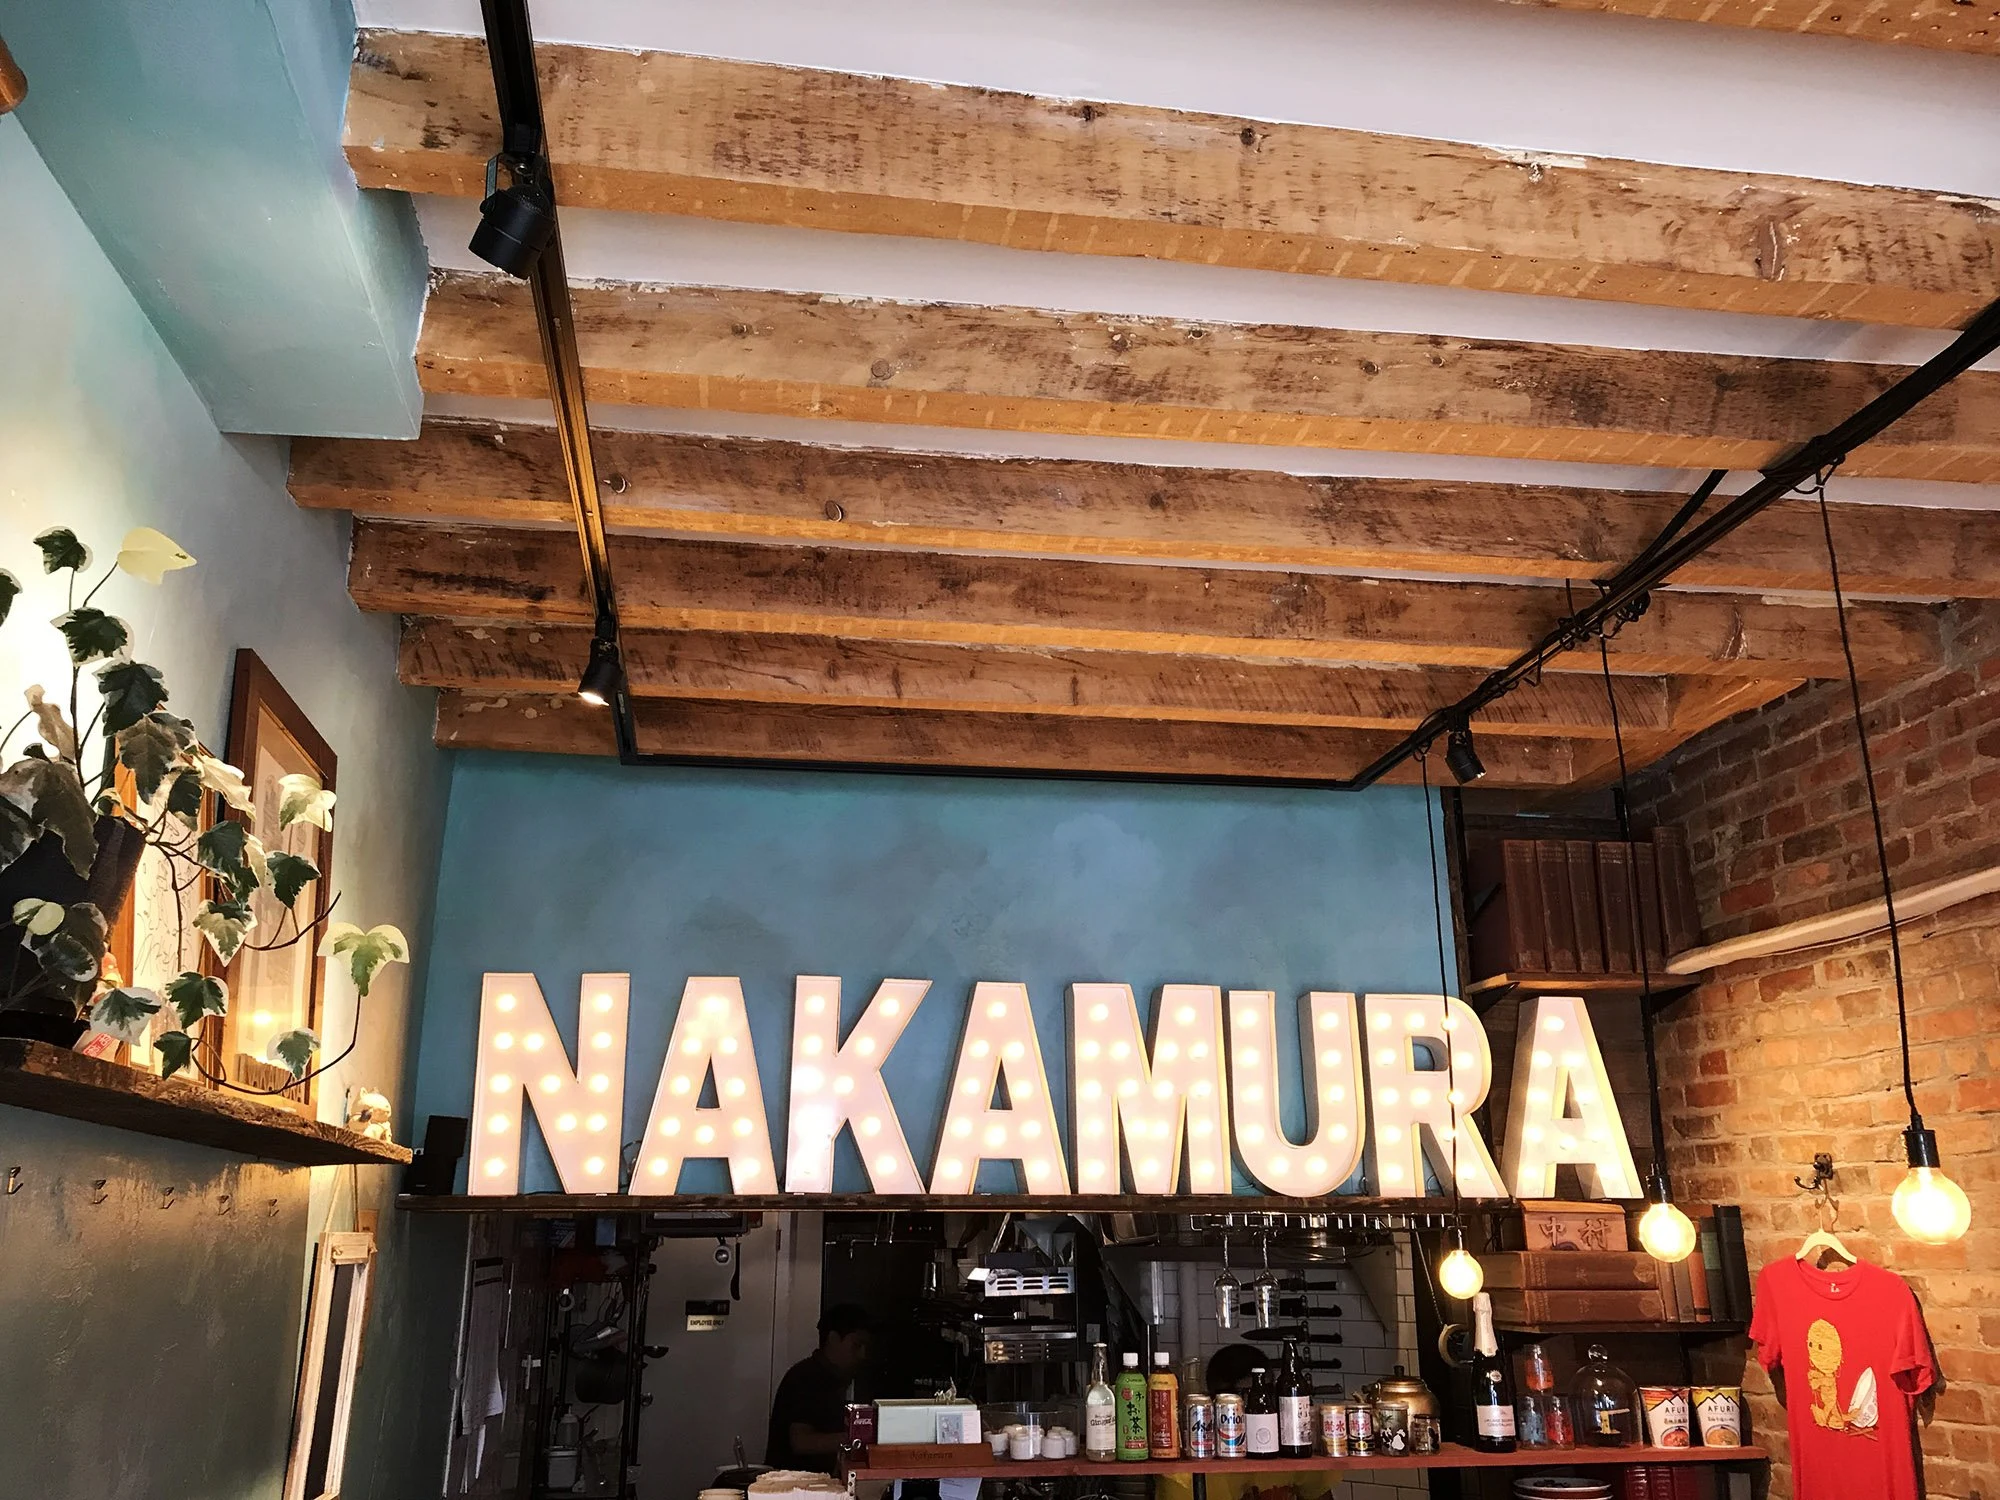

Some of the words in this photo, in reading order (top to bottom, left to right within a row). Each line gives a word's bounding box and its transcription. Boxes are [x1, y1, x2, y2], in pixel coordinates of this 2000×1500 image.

[467, 971, 1645, 1199] NAKAMURA
[1539, 1215, 1613, 1249] 中村
[1707, 1405, 1735, 1413] AFURI
